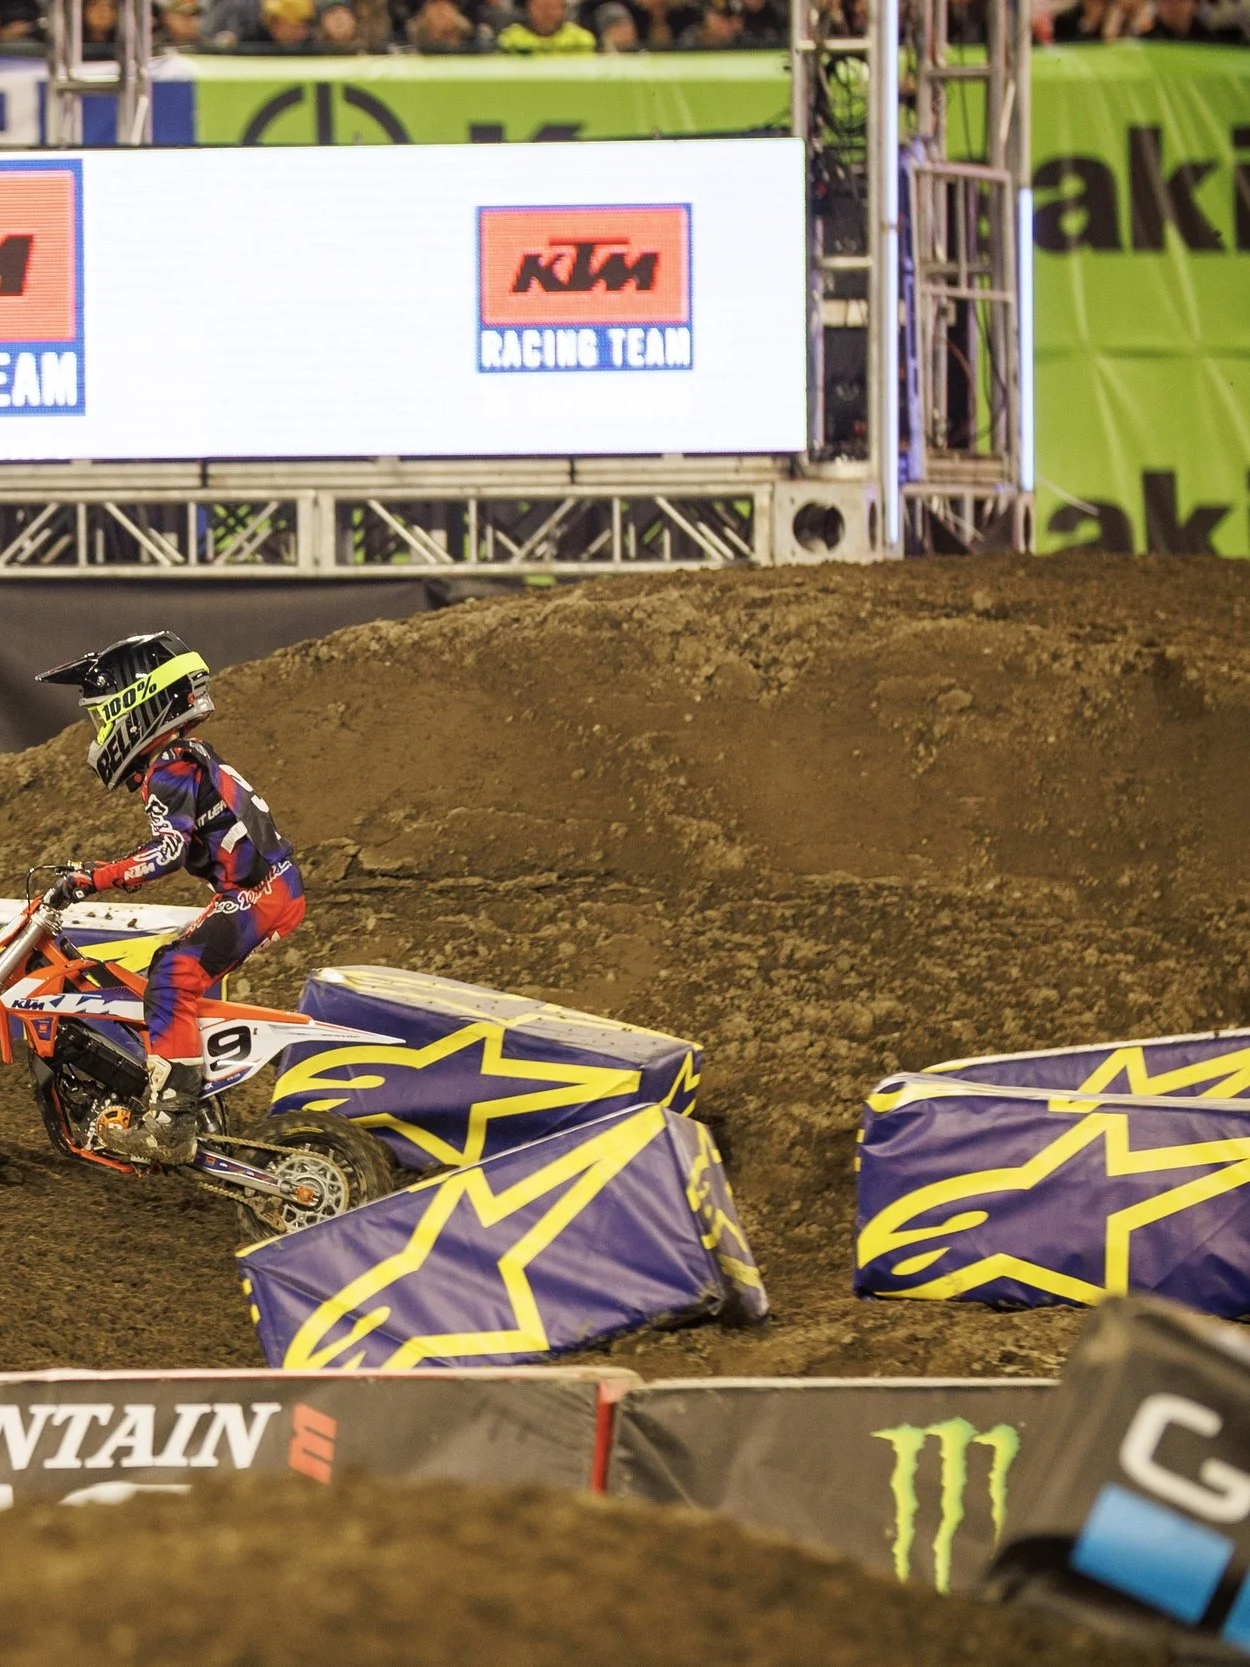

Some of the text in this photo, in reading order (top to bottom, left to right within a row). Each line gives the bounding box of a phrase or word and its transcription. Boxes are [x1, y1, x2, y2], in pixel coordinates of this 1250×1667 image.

[511, 237, 659, 293] KTM
[481, 327, 691, 367] RACING TEAM
[102, 675, 157, 721] 100%
[124, 862, 156, 881] KTM
[11, 998, 45, 1010] KTM
[207, 1025, 252, 1072] 9
